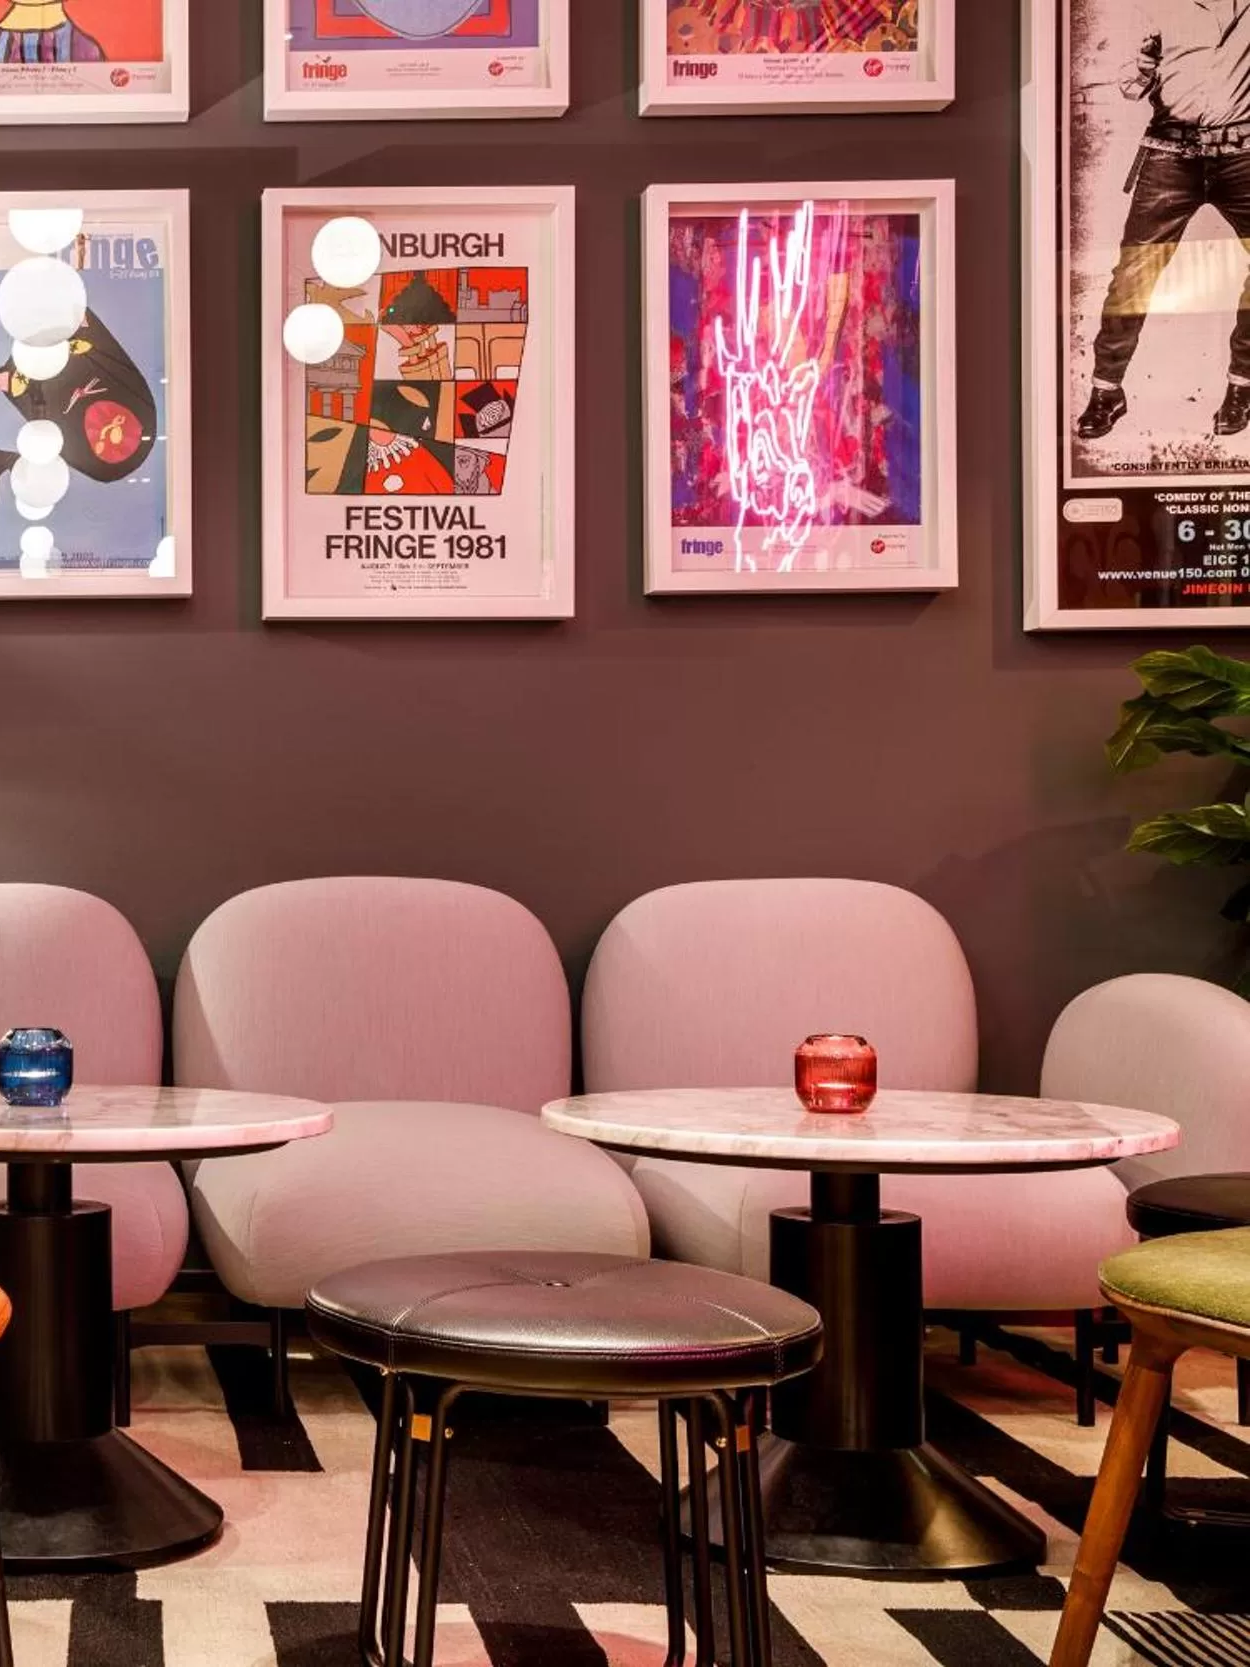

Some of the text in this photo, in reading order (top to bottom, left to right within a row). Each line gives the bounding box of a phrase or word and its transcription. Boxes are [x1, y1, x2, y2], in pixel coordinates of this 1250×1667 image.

[302, 61, 348, 81] fringe
[672, 60, 718, 79] fringe
[379, 232, 505, 259] NBURGH
[1209, 491, 1225, 502] OF
[345, 505, 486, 531] FESTIVAL
[1177, 520, 1196, 542] 6
[325, 534, 506, 560] FRINGE 1981
[681, 538, 724, 556] fringe
[1203, 554, 1238, 566] EICC
[1097, 567, 1238, 580] www.venue150.com
